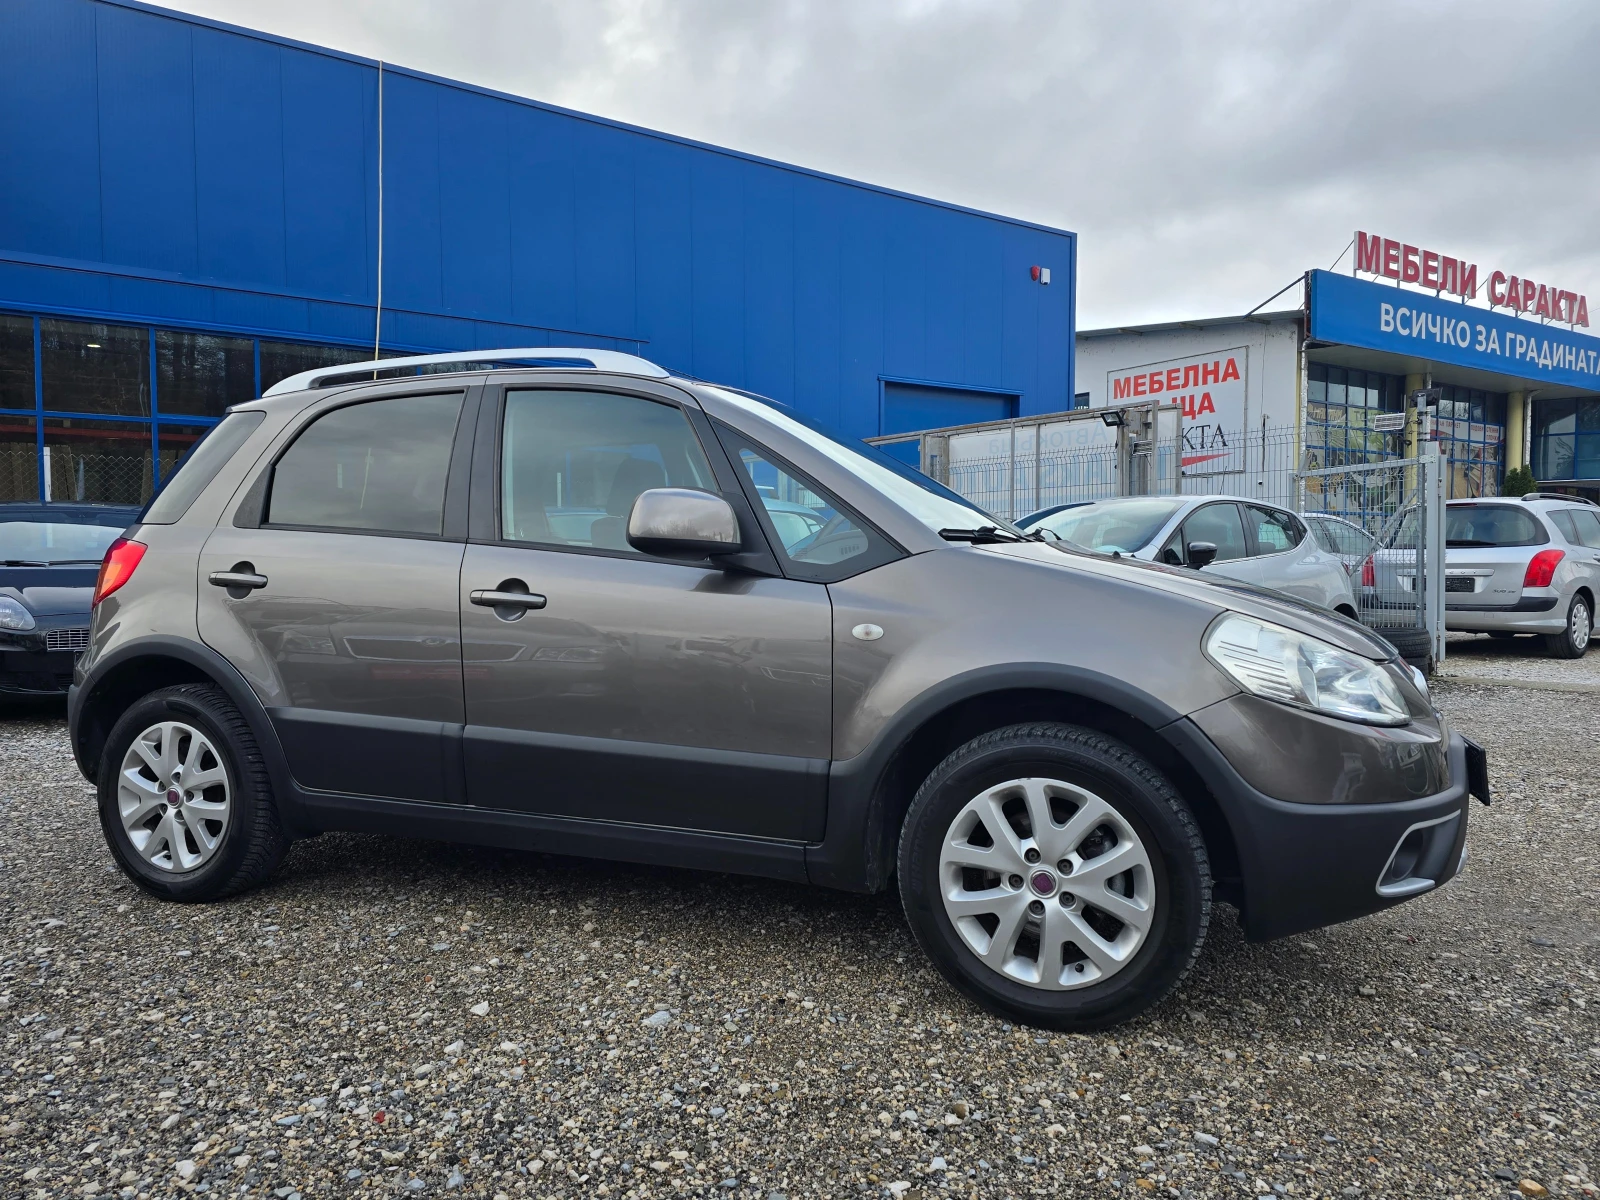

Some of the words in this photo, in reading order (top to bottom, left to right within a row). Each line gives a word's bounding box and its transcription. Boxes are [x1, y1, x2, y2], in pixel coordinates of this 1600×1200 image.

[1354, 230, 1477, 299] МЕБЕЛИ
[1487, 270, 1590, 328] САРАКТА
[1380, 302, 1471, 348] ВСИЧКО
[1475, 324, 1501, 356] ЗА
[1113, 357, 1240, 399] МЕБЕЛНА
